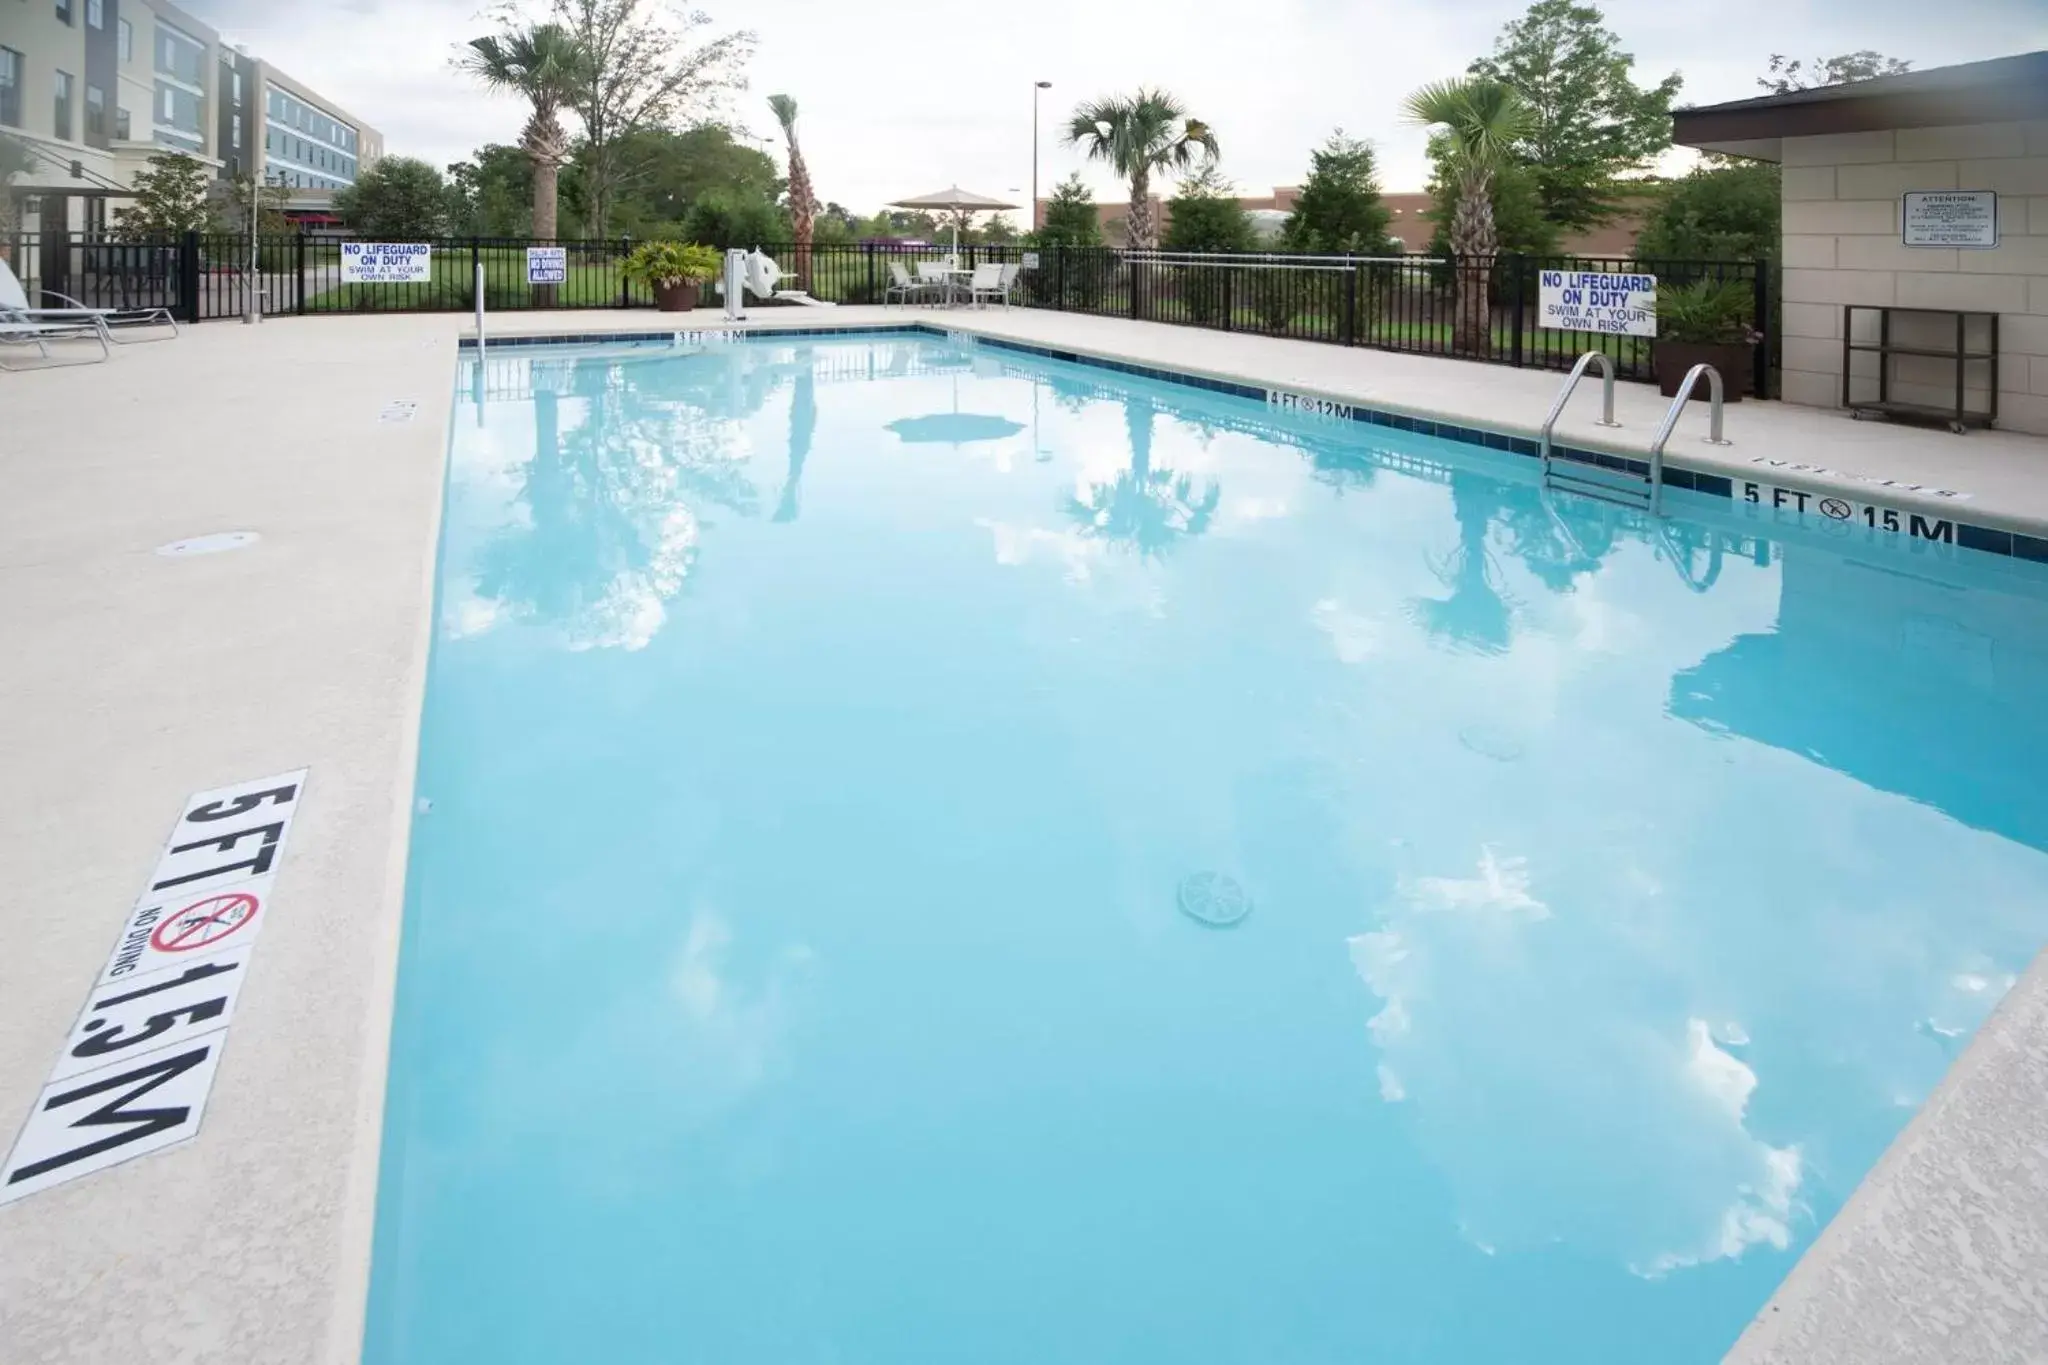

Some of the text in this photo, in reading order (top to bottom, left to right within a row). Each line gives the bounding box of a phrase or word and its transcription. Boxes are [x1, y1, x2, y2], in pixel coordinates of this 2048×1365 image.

[344, 245, 428, 255] NO LIFEGUARD
[361, 255, 412, 265] ON DUTY
[349, 265, 424, 274] SWIM AT YOUR
[361, 273, 412, 281] OWN RISK
[1543, 272, 1653, 292] NO LIFEGUARD
[1562, 289, 1629, 308] ON DUTY
[1547, 304, 1646, 322] SWIM AT YOUR
[1562, 317, 1628, 332] OWN RISK
[1744, 482, 1760, 504] 5
[1773, 487, 1812, 513] FT
[109, 906, 163, 977] NO DIVING
